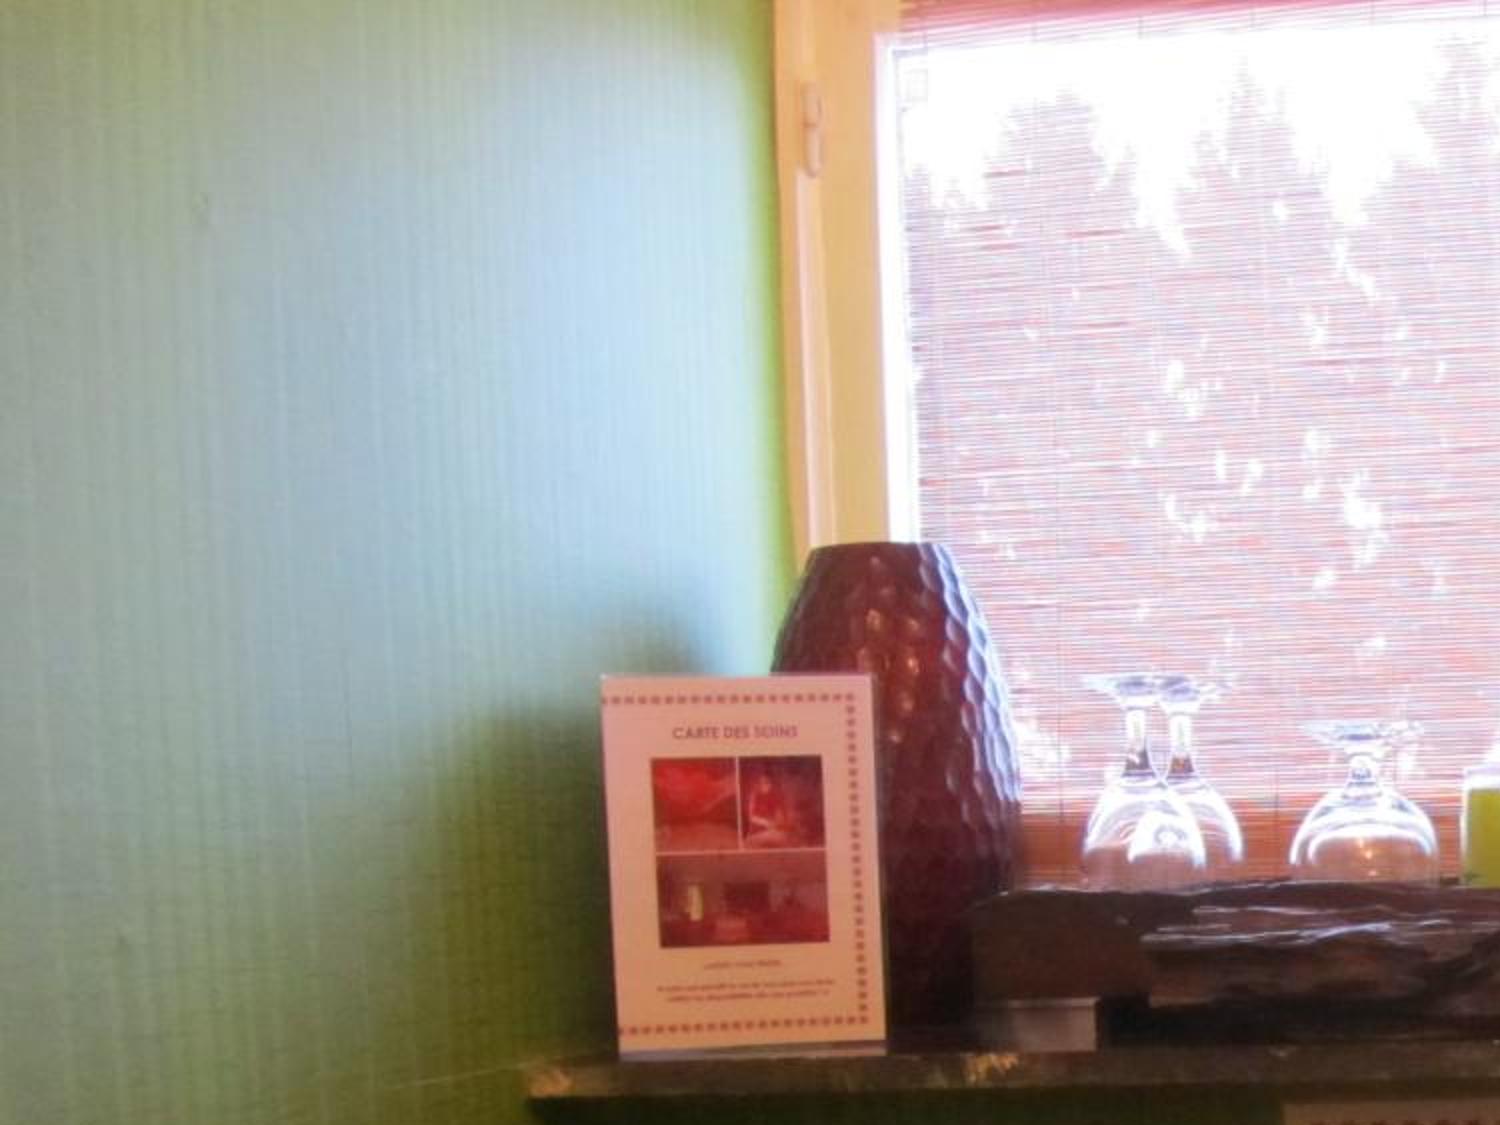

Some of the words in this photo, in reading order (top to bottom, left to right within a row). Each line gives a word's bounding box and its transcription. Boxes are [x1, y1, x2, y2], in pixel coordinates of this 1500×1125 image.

[671, 726, 720, 740] CARTE
[723, 725, 750, 739] DES
[753, 724, 798, 739] SOINS
